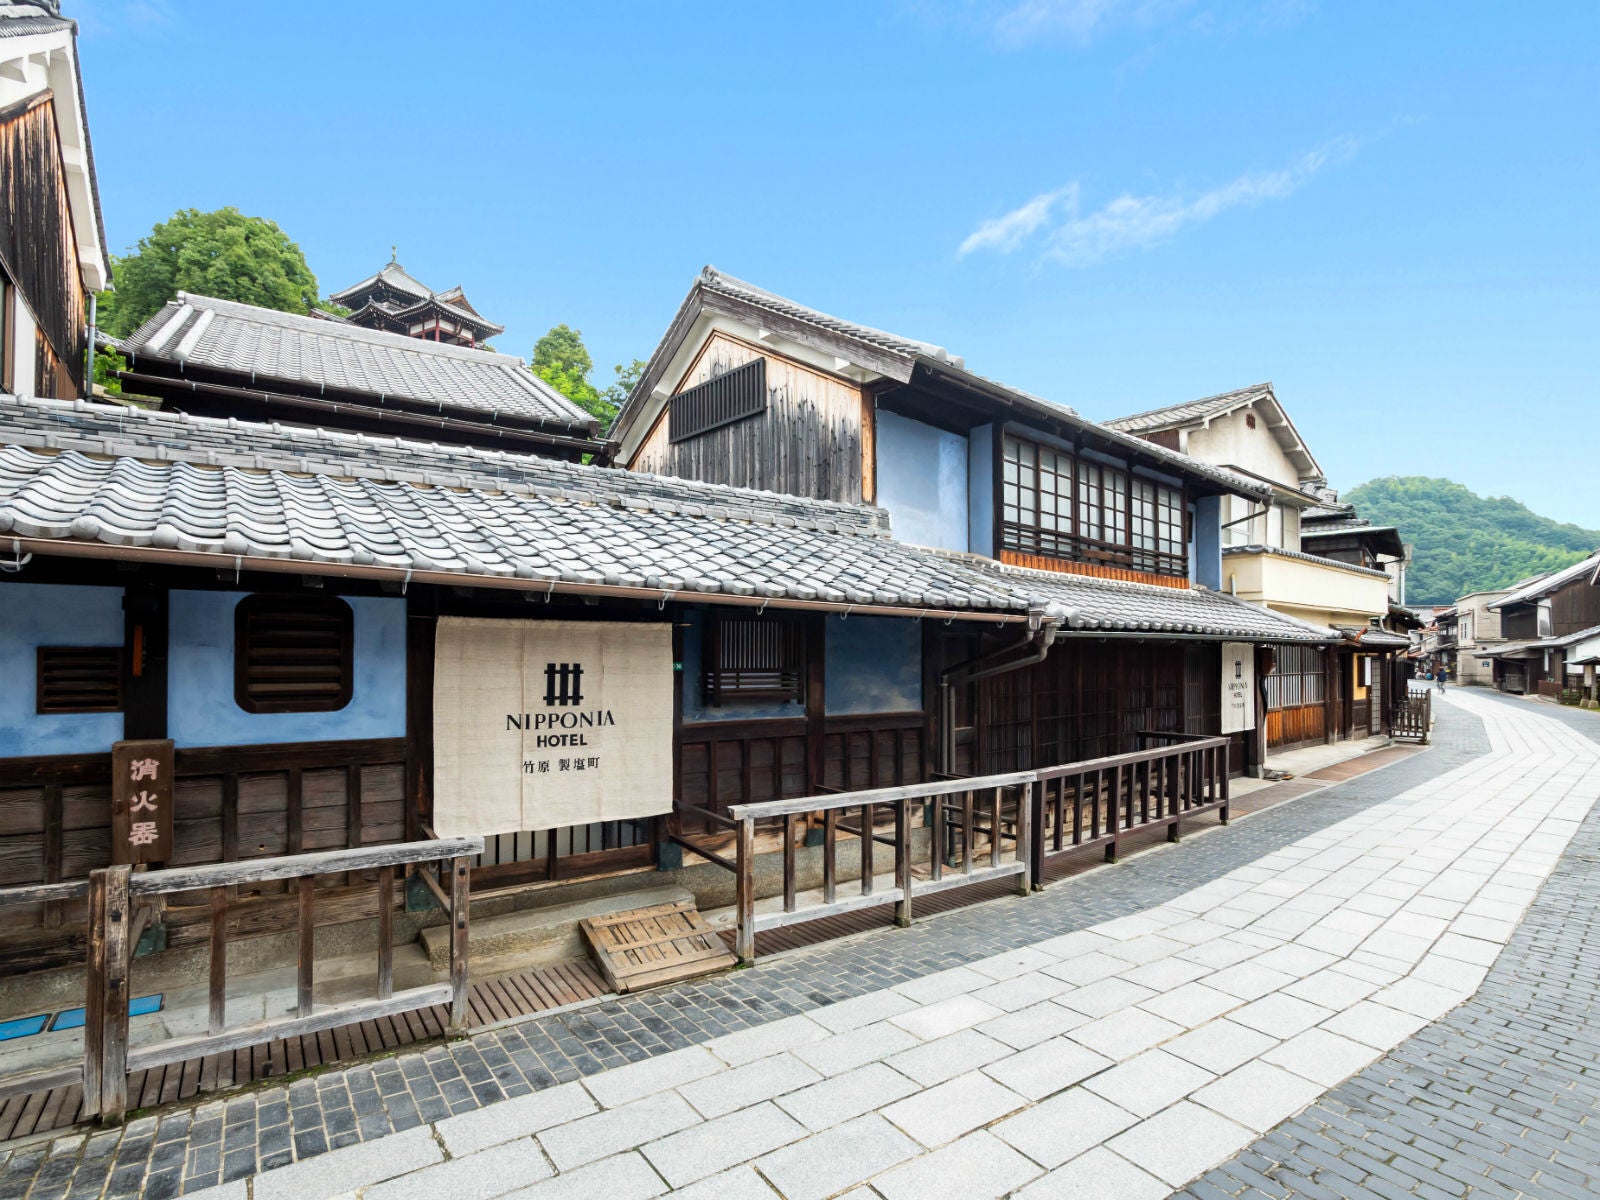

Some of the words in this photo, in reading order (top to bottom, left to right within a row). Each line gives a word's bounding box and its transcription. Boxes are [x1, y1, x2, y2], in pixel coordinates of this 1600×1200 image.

[506, 709, 616, 731] NIPPONIA
[536, 733, 588, 748] HOTEL
[522, 760, 550, 774] 竹原
[559, 756, 600, 772] 製塩町
[128, 758, 160, 846] 消火器
